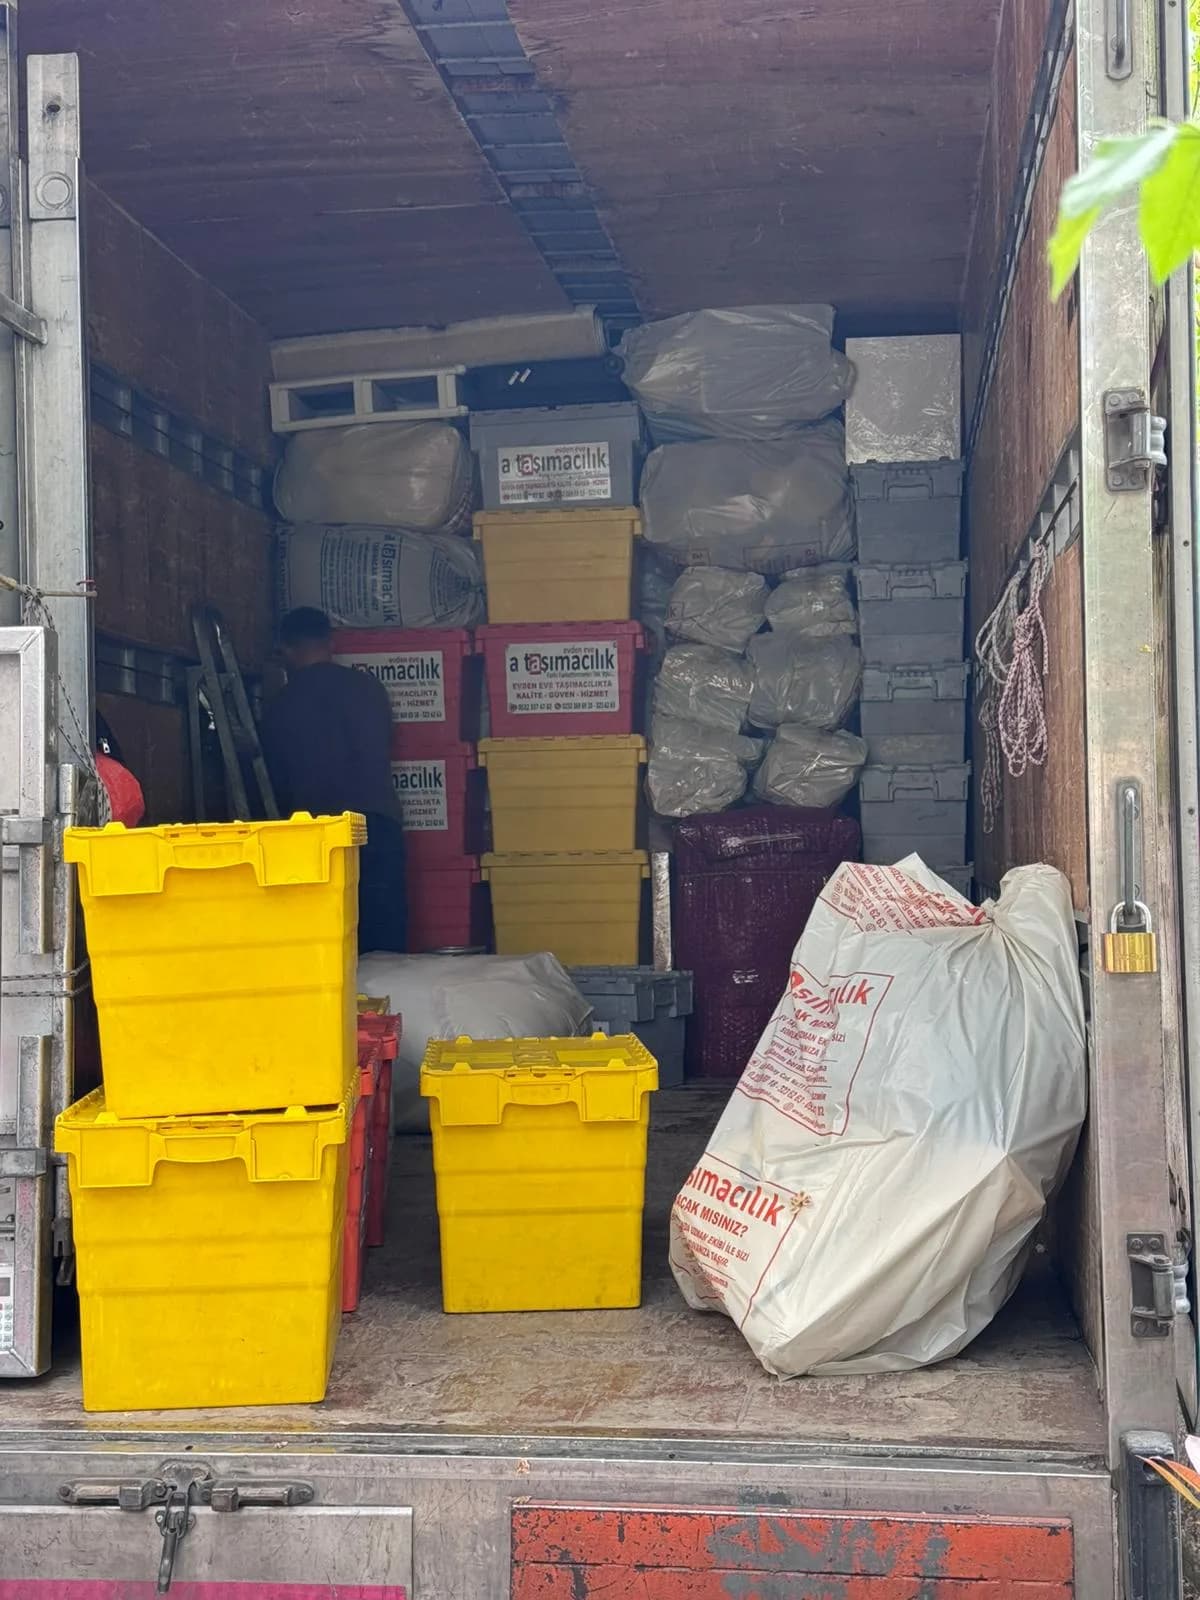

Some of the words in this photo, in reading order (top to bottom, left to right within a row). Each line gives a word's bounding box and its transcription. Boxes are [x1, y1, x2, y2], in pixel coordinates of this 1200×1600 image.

[502, 457, 511, 474] a
[515, 447, 607, 476] taşımacılık
[509, 656, 519, 673] a
[524, 647, 615, 676] taşımacılık
[512, 682, 537, 690] EVDEN
[556, 680, 613, 689] TAŞIMACILIKTA
[516, 691, 543, 700] KALİTE
[580, 690, 609, 698] HİZMET
[868, 907, 881, 920] 62
[875, 917, 888, 929] 63
[699, 1205, 749, 1238] MISINIZ?
